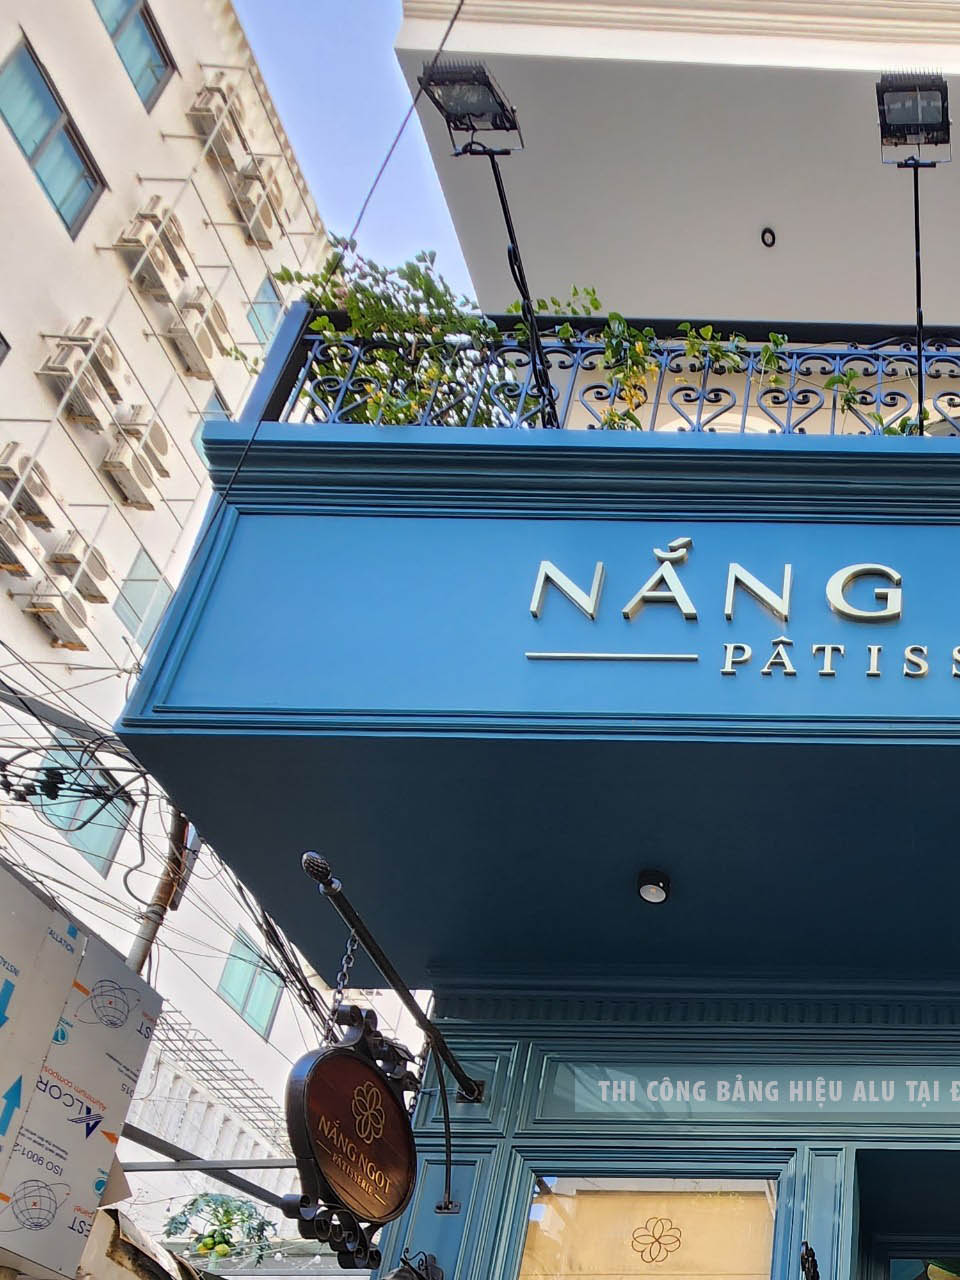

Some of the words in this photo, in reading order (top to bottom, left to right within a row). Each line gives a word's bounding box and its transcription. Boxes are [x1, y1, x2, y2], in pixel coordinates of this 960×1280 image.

[529, 537, 902, 622] NẮNG
[318, 1115, 357, 1162] NẮNG
[358, 1156, 392, 1194] NGỌT
